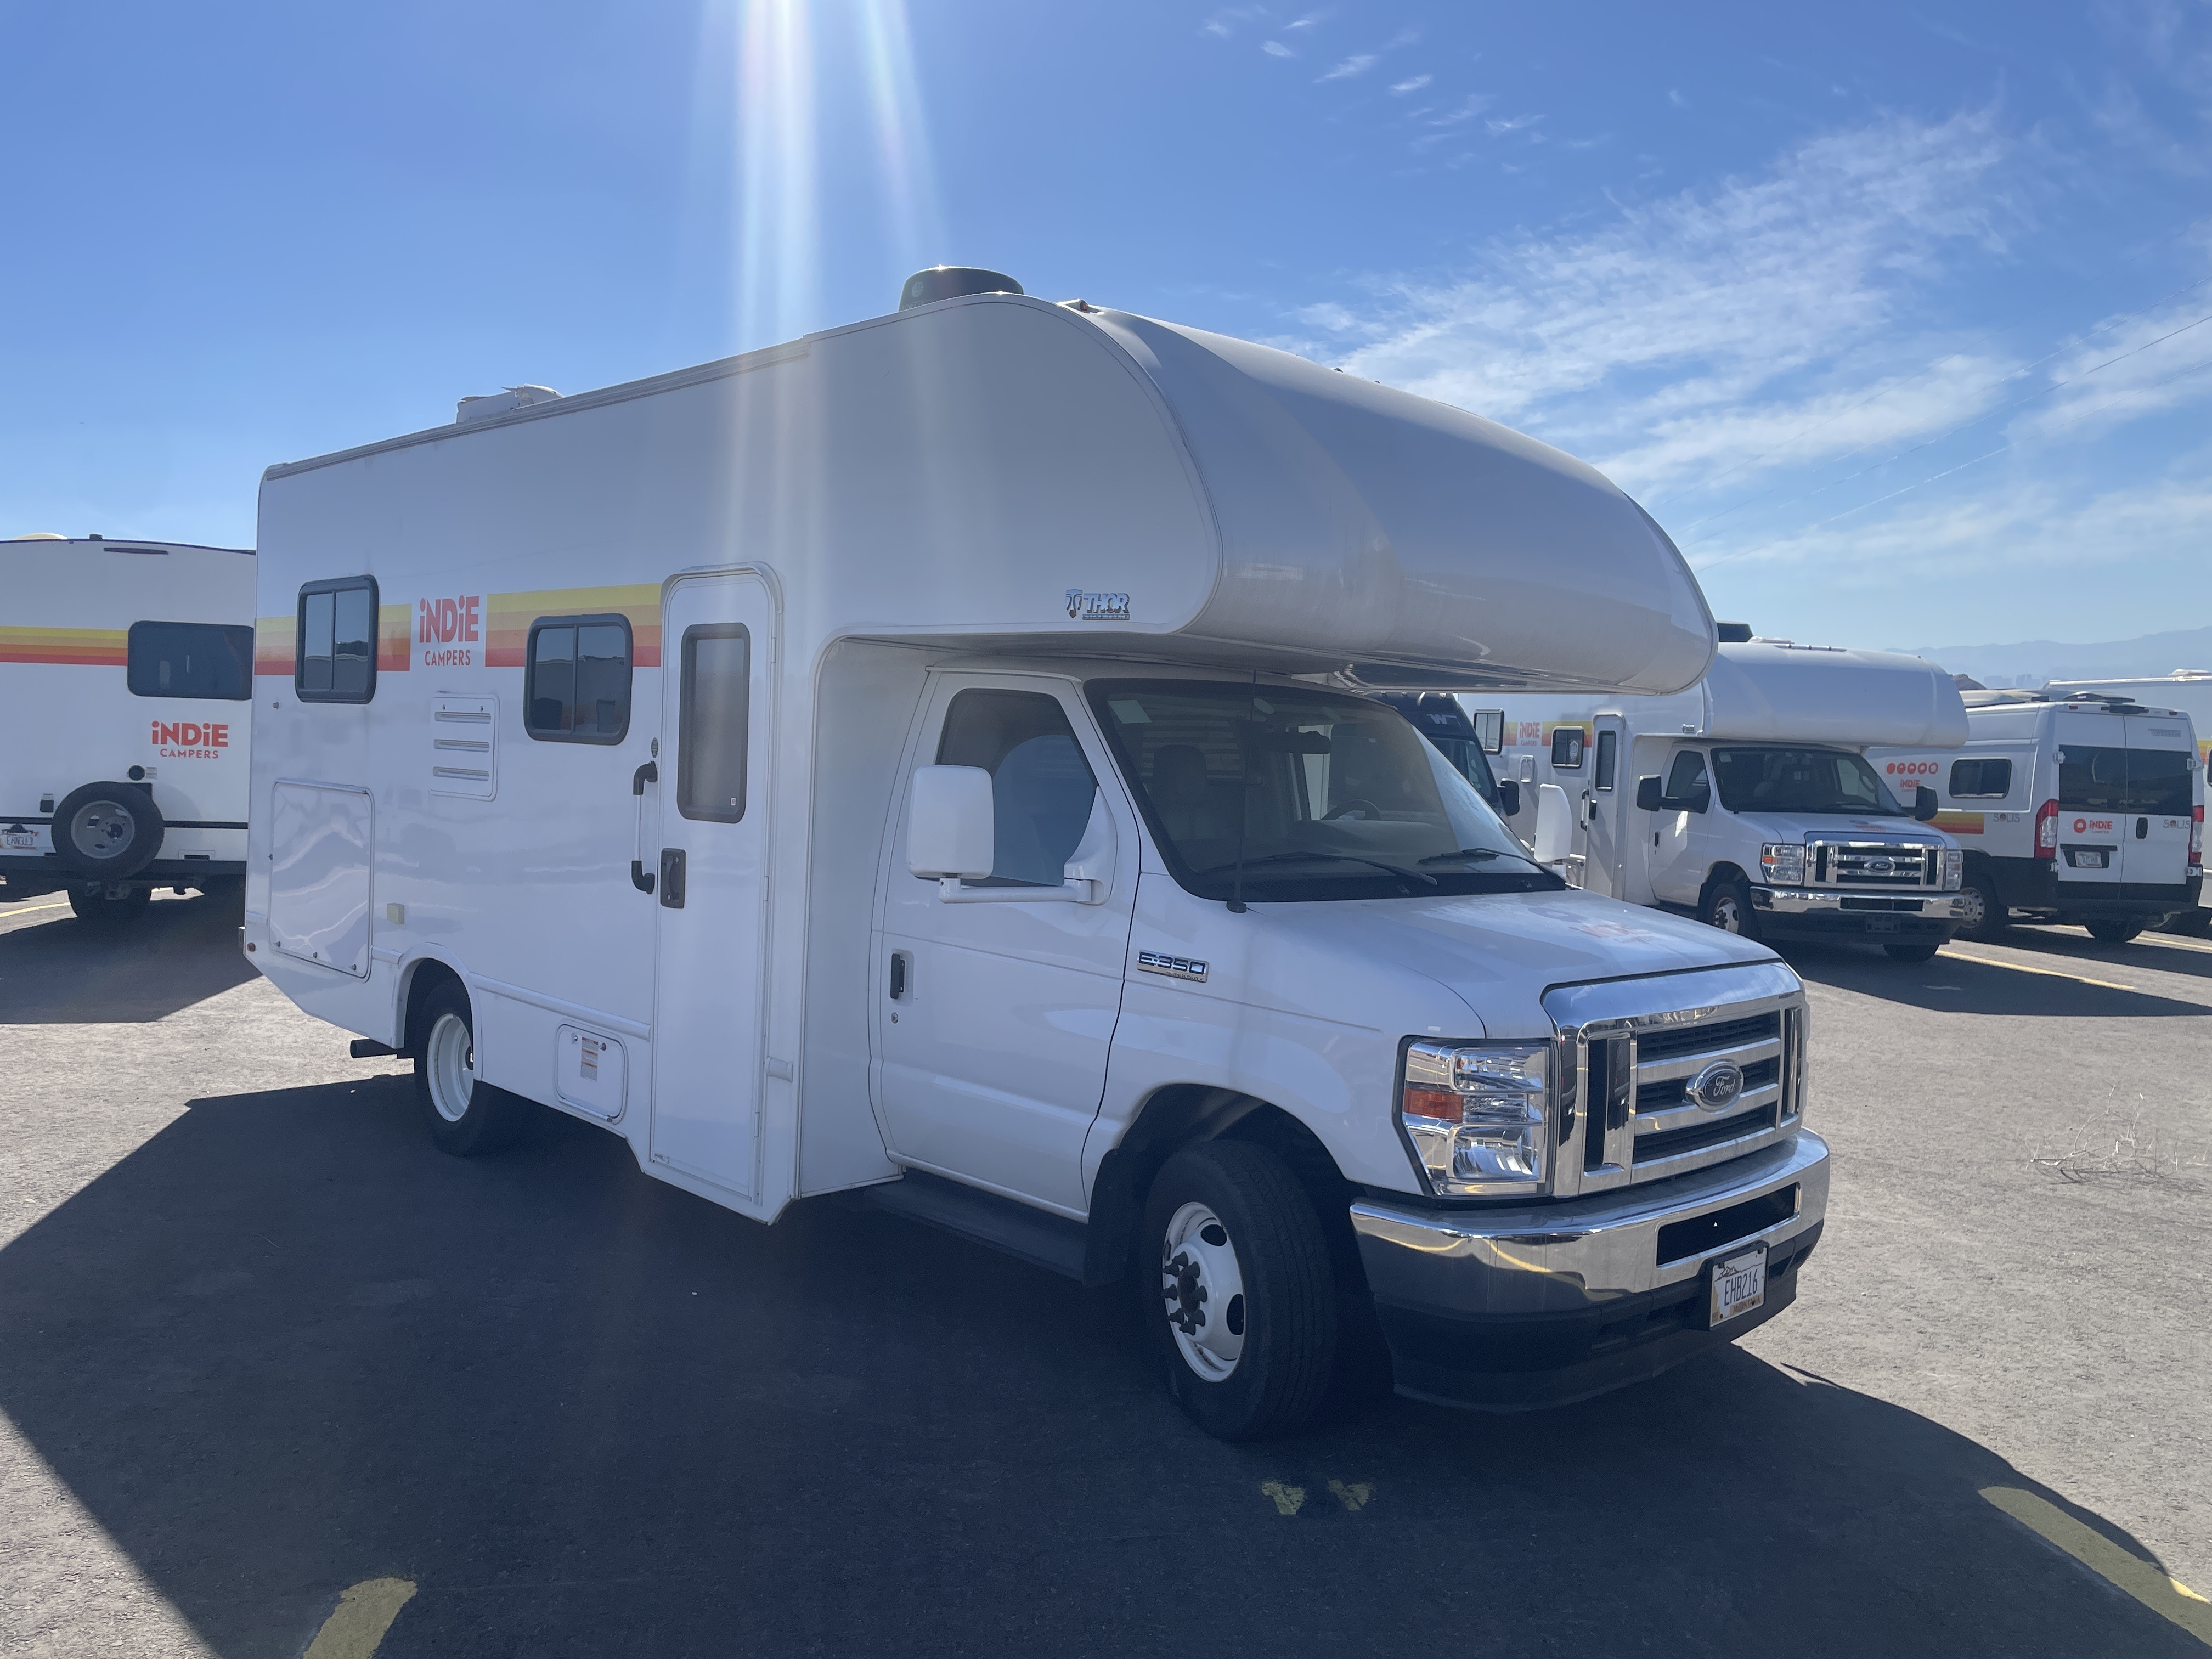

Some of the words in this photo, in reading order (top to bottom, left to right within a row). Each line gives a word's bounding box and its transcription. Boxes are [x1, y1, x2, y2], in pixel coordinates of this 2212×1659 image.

[1084, 593, 1130, 613] THOR
[425, 649, 470, 666] CAMPERS
[160, 748, 219, 759] CAMPERS
[1166, 971, 1186, 979] SUPER
[1713, 1075, 1736, 1097] Ford
[1724, 1268, 1758, 1306] EHB216
